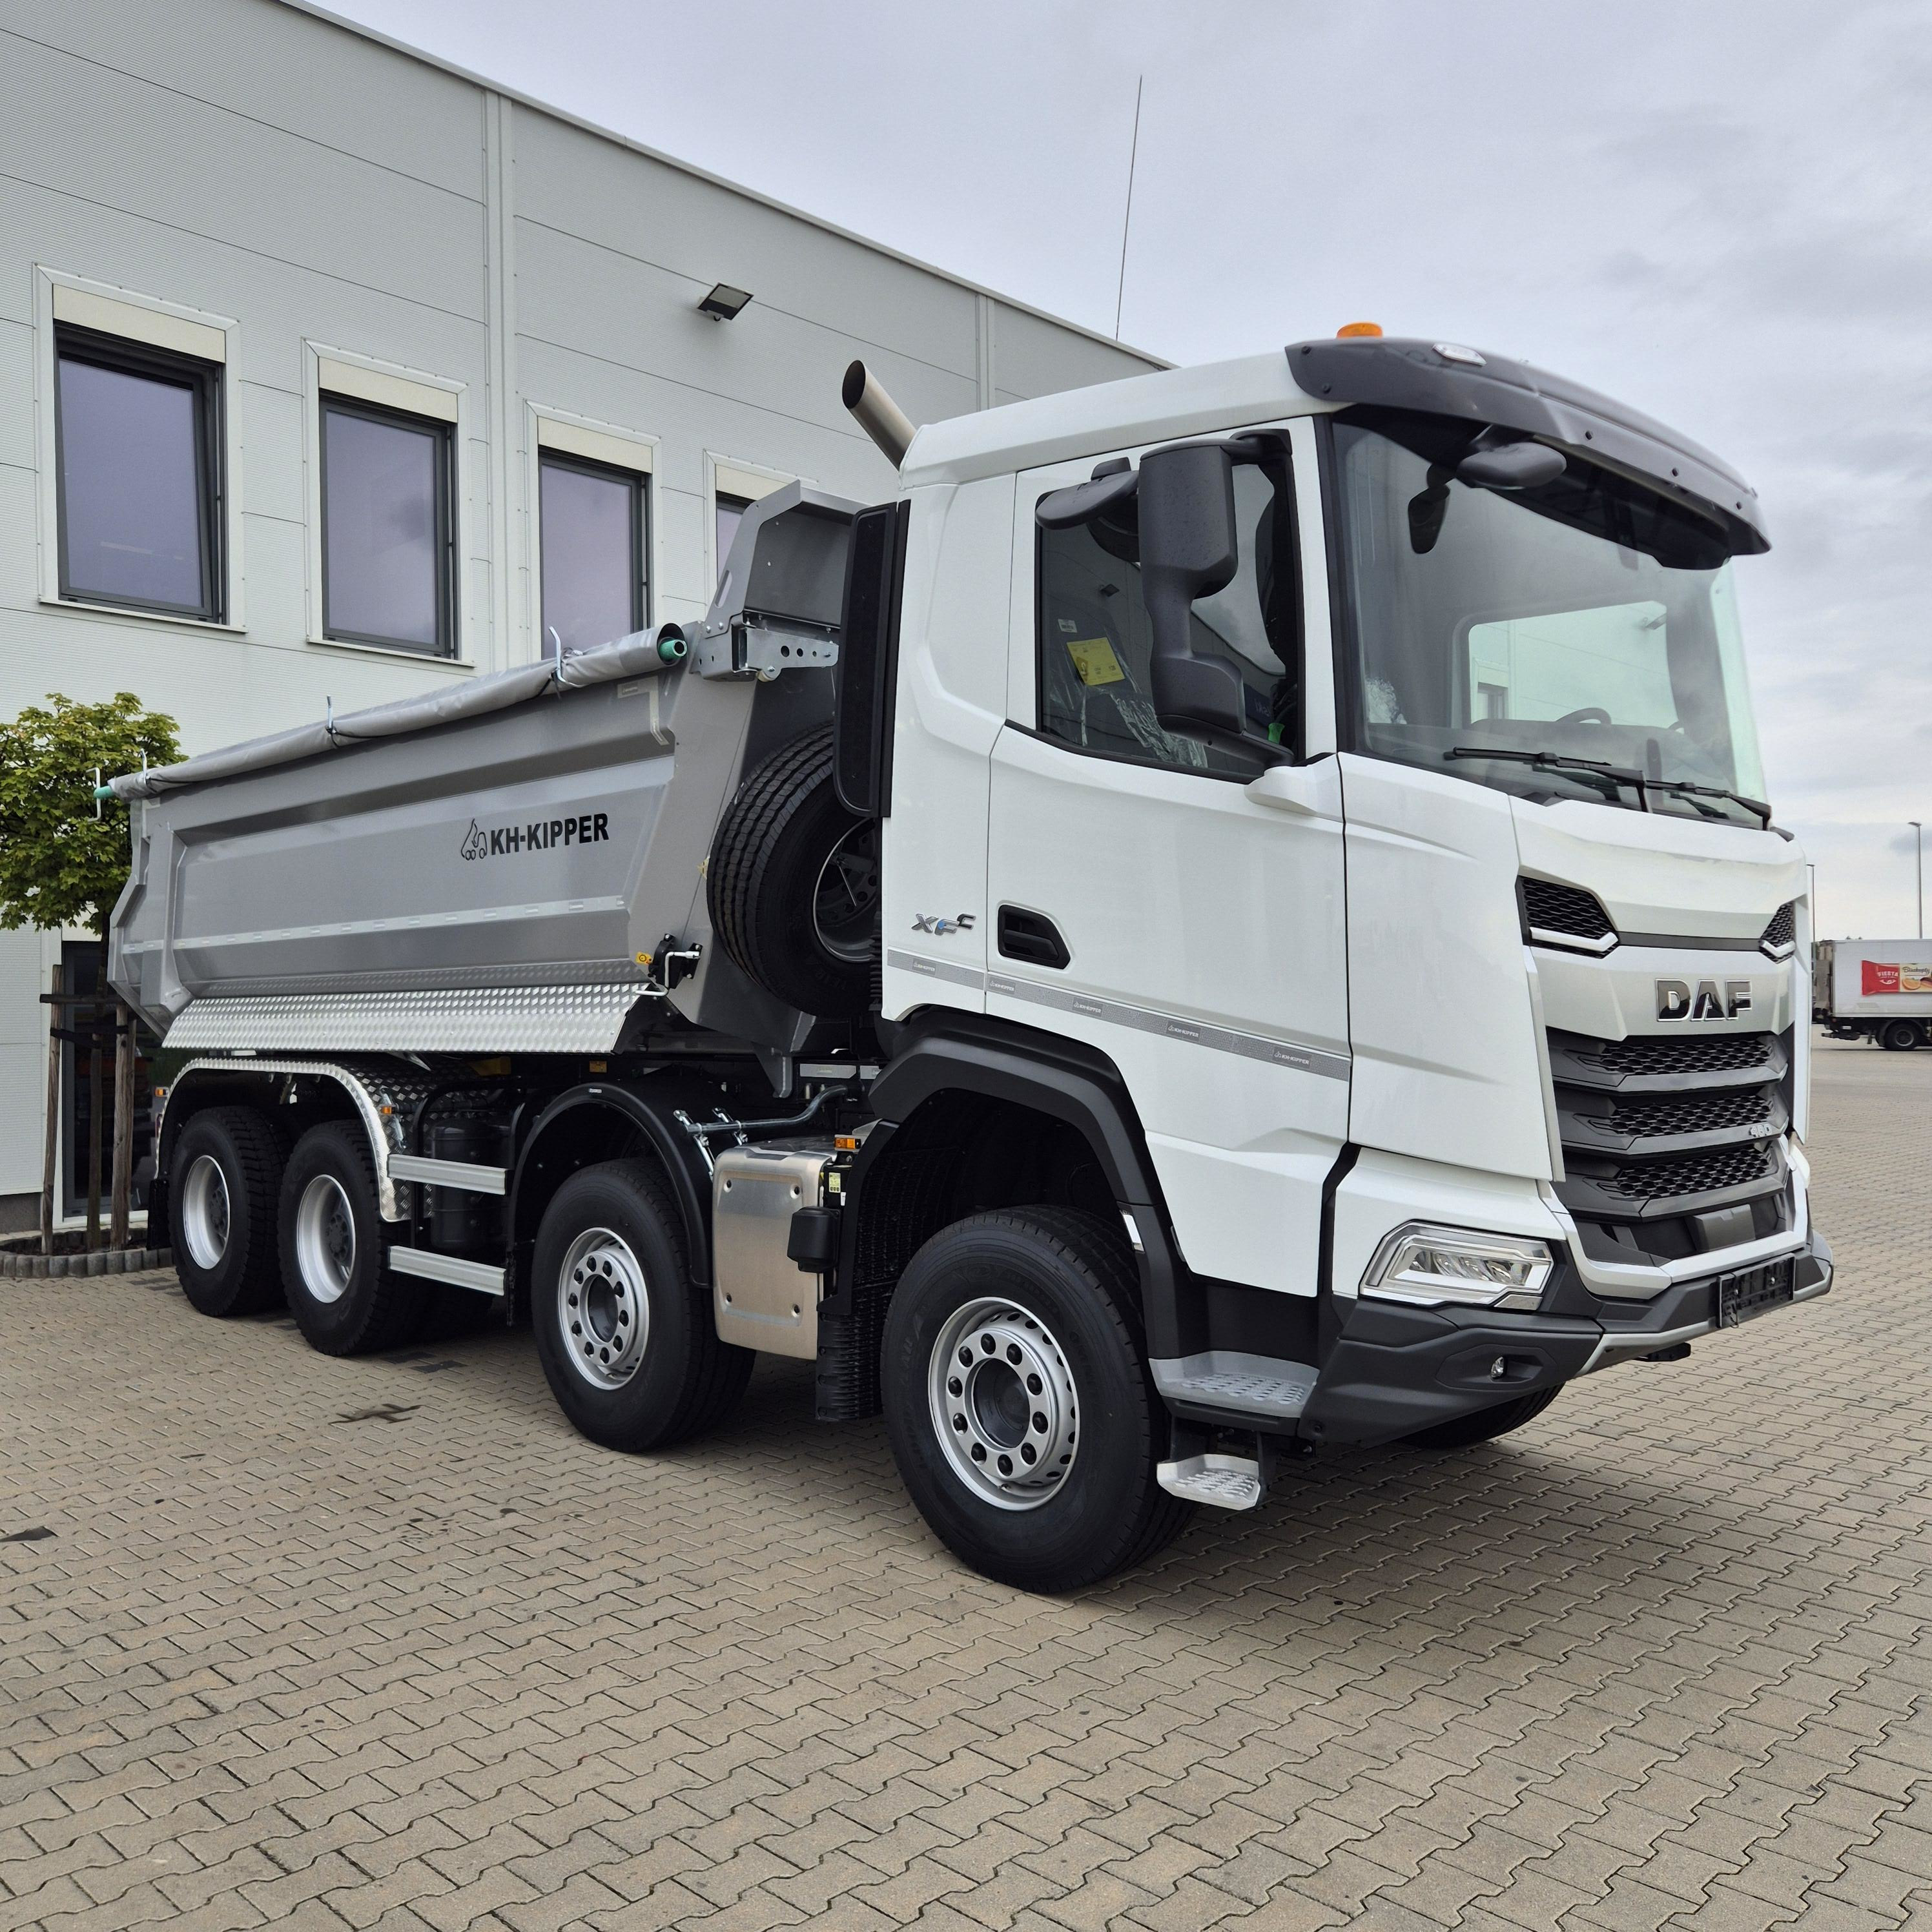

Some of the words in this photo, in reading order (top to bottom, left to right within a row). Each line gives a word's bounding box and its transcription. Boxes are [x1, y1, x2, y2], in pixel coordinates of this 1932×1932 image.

[491, 814, 609, 855] KH-KIPPER
[911, 913, 976, 936] XFC
[1655, 978, 1752, 1022] DAF
[1282, 1054, 1310, 1065] KH-KIPPER
